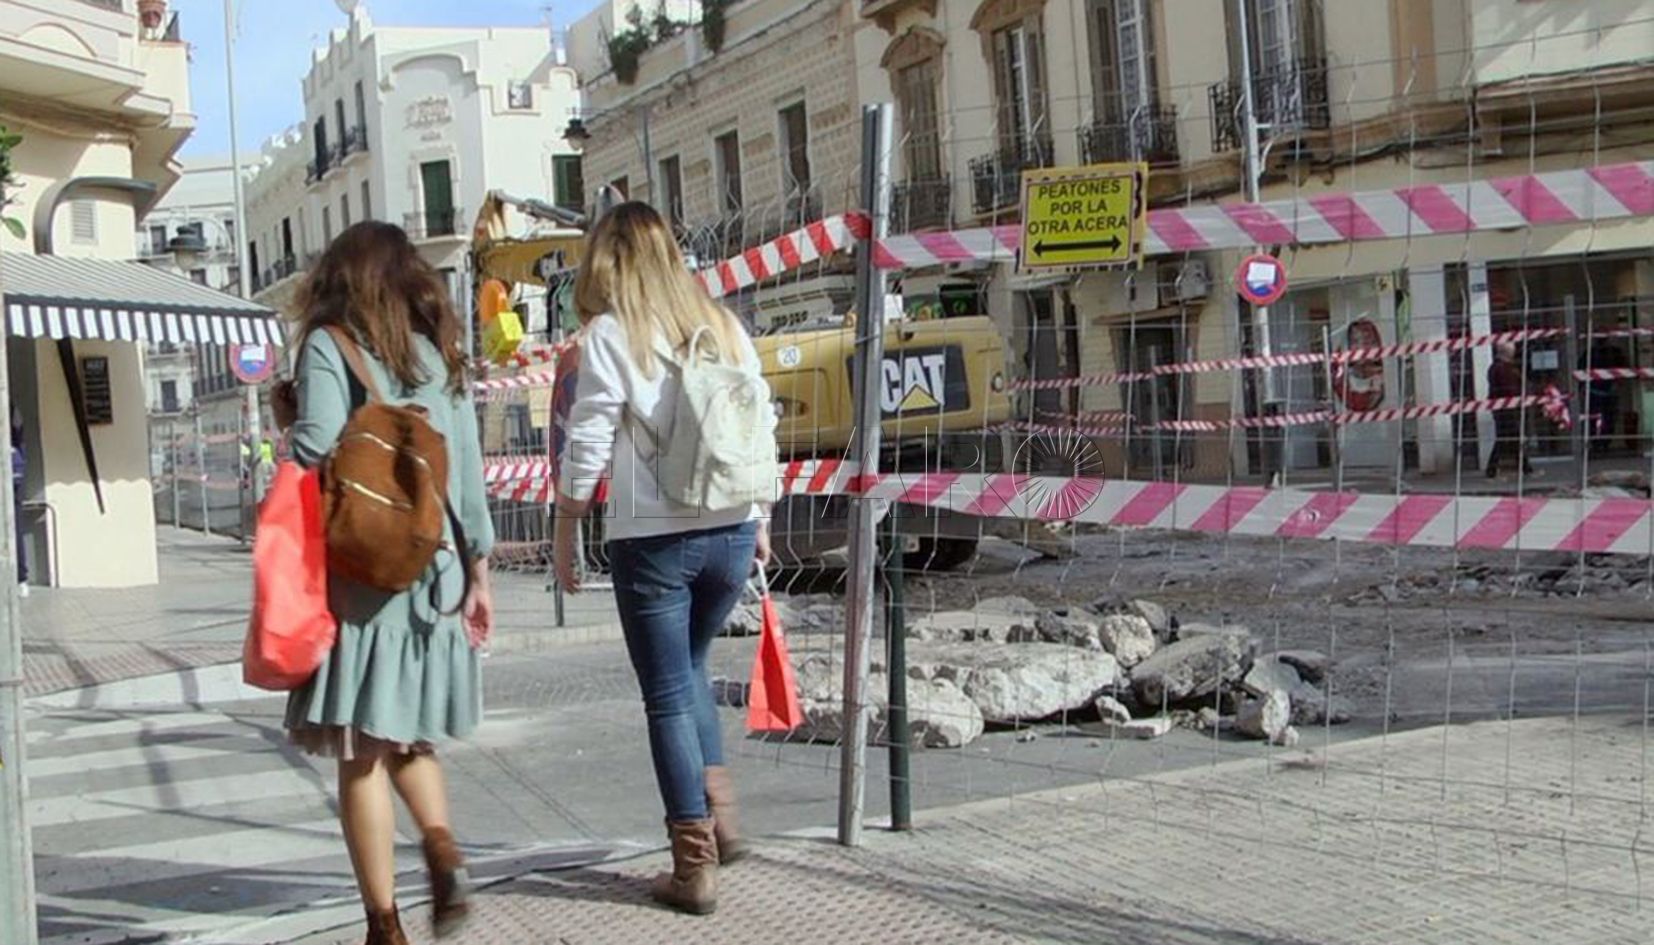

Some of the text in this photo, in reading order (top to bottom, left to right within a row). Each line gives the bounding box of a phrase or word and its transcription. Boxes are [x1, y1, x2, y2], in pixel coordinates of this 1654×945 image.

[1038, 180, 1120, 198] PEATONES
[1050, 199, 1107, 215] POR LA
[1028, 215, 1127, 235] OTRA ACERA
[880, 354, 945, 412] CAT
